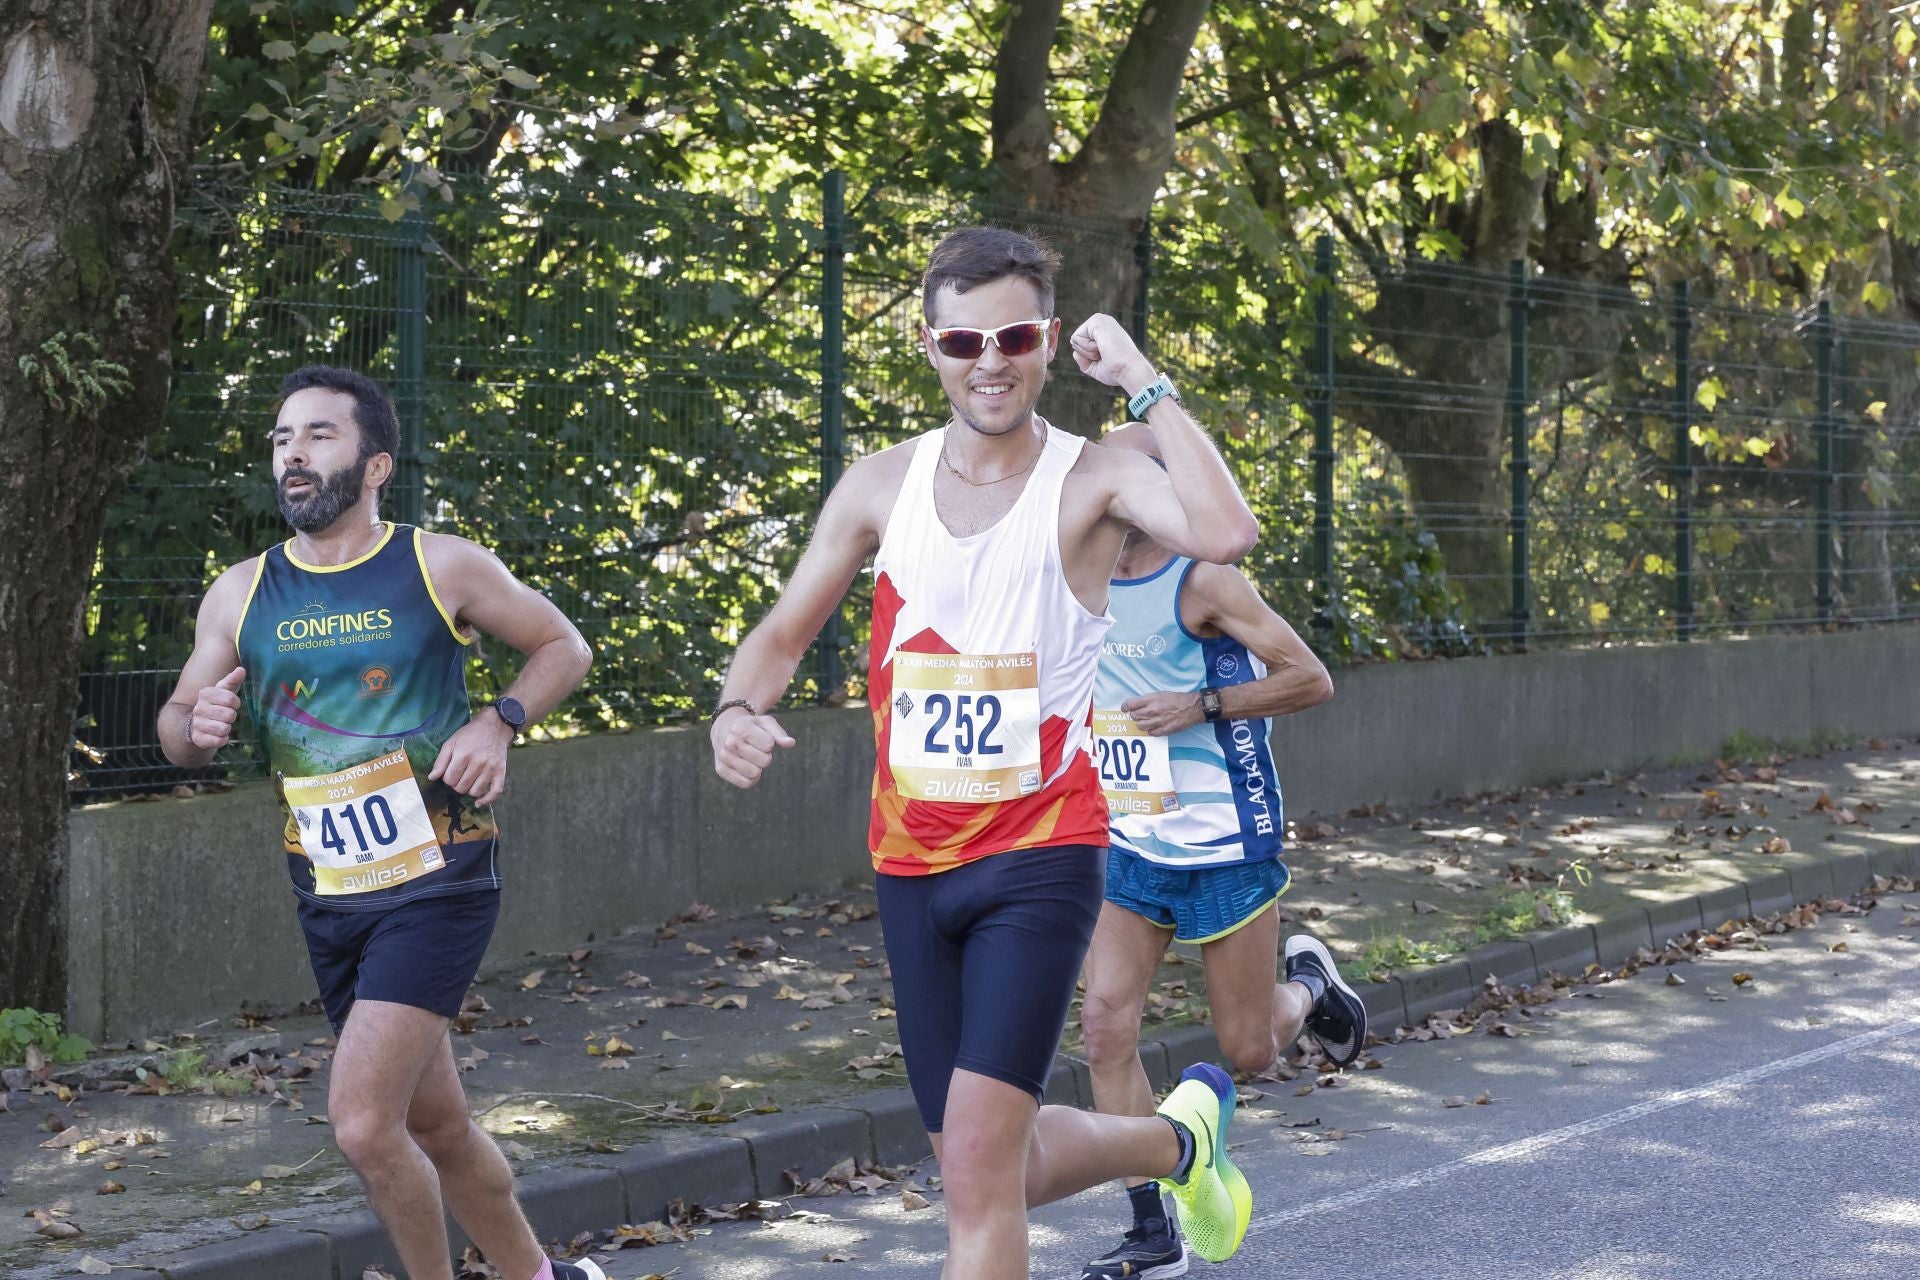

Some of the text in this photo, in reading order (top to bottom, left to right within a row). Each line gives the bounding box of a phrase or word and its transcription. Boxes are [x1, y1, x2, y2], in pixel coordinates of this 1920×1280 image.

[276, 608, 393, 641] CONFINES
[278, 630, 392, 652] corredores solidarios
[925, 658, 957, 669] MEDIA
[996, 654, 1033, 669] AVILÉS
[954, 674, 974, 686] 2024
[924, 693, 1004, 755] 252
[1106, 724, 1128, 733] 2024
[1098, 738, 1150, 781] 202
[327, 765, 371, 786] MARATÓN
[373, 752, 404, 772] AVILÉS
[327, 785, 354, 799] 2024
[1114, 782, 1138, 791] ARMANDO
[321, 794, 398, 856] 410
[355, 852, 375, 863] DAMI
